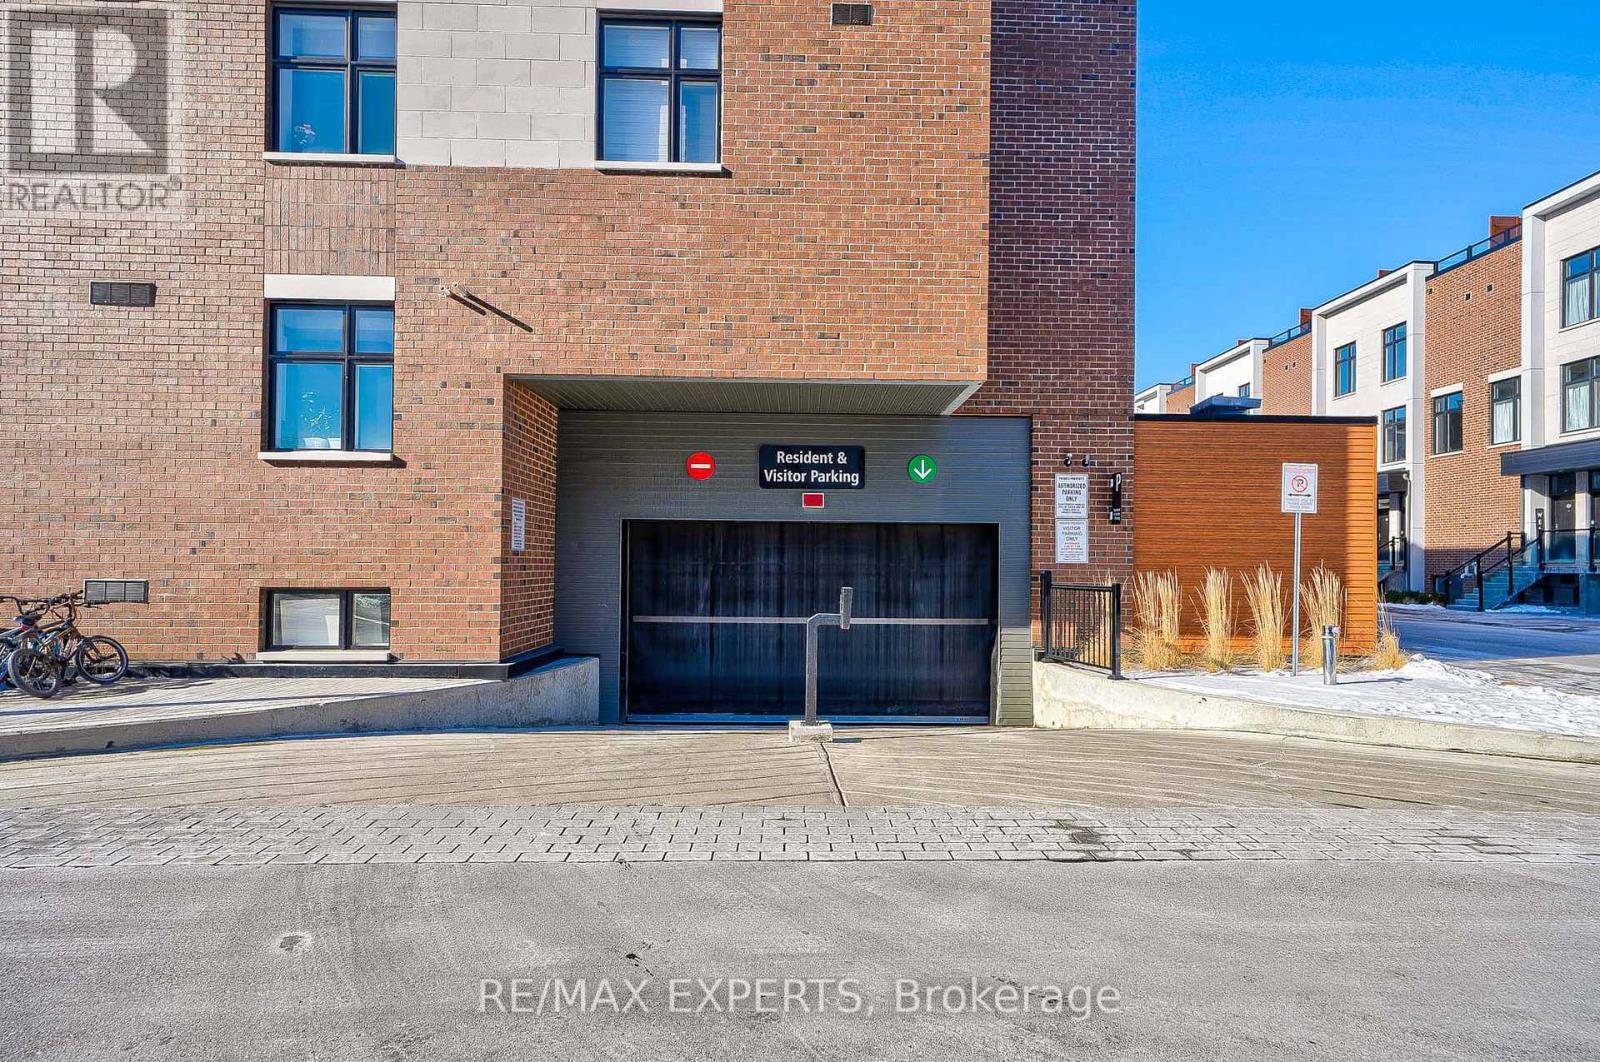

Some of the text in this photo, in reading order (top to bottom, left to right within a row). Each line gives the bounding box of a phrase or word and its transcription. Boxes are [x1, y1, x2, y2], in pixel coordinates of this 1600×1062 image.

[776, 450, 848, 465] Resident &
[763, 469, 860, 486] Visitor Parking
